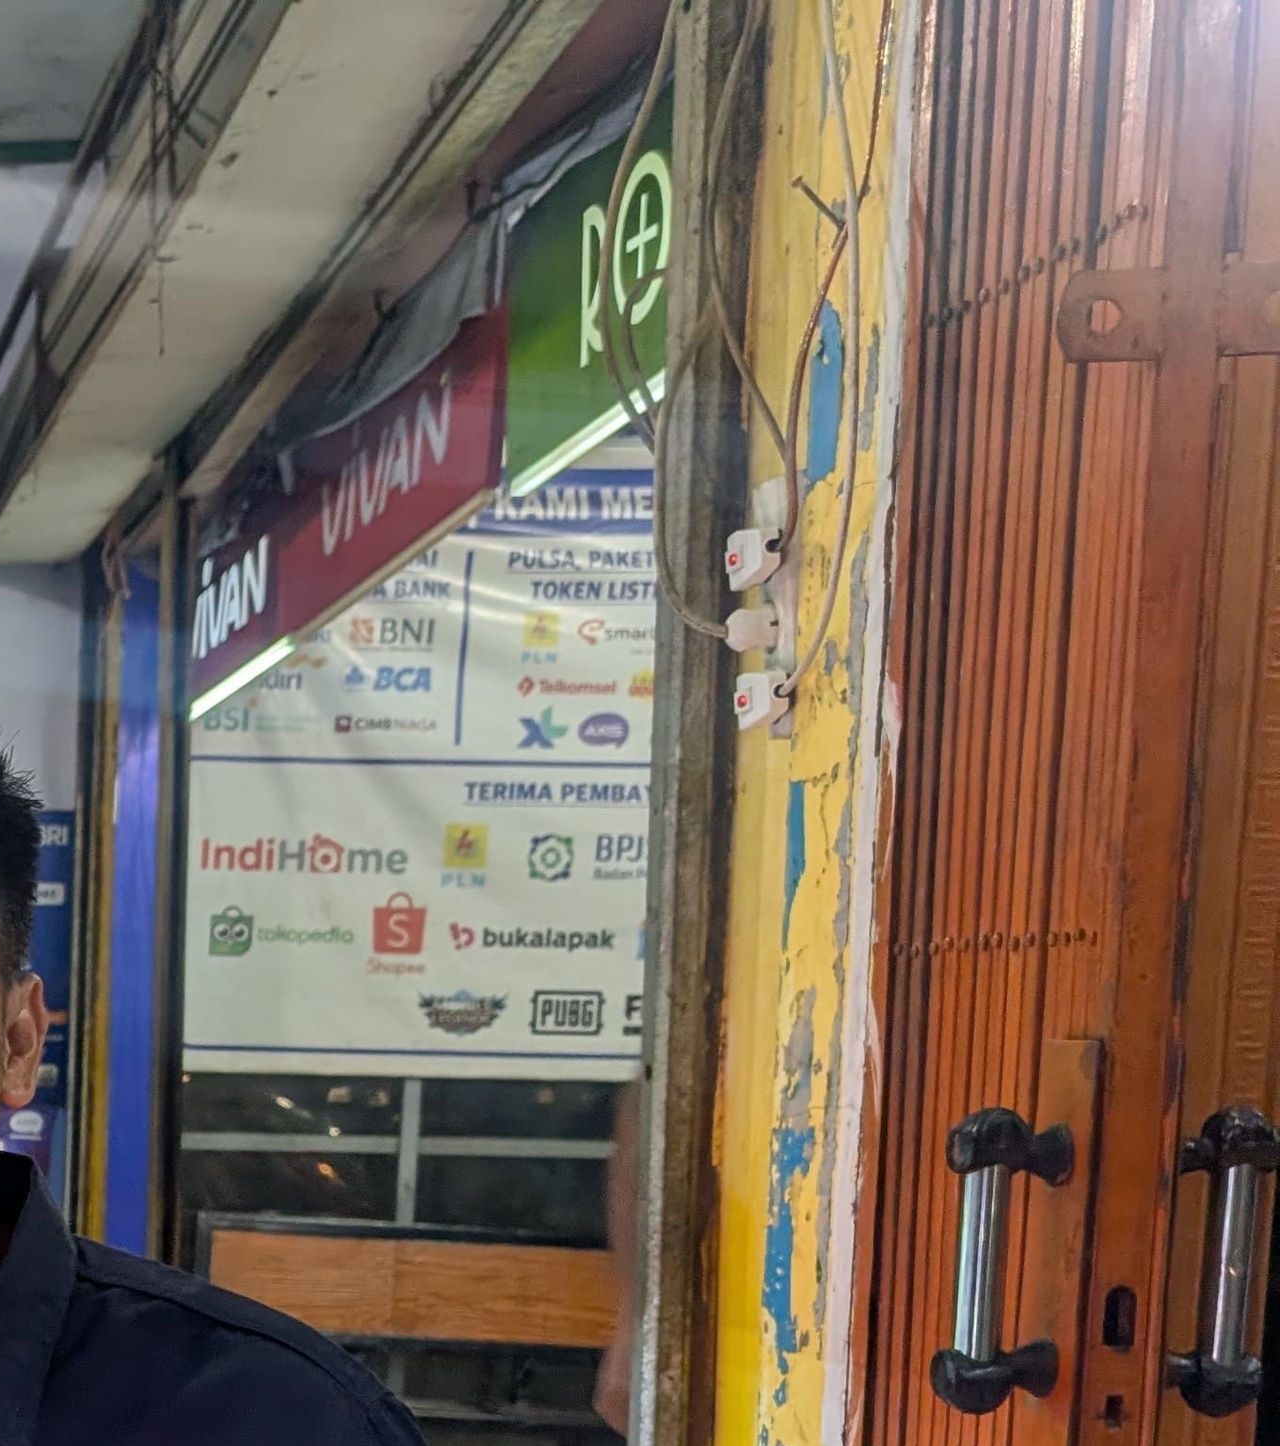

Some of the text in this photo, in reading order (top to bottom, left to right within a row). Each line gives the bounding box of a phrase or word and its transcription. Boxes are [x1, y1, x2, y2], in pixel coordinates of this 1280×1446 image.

[531, 581, 601, 600] TOKEN
[380, 618, 436, 644] BNI
[373, 666, 432, 692] BCA
[538, 678, 617, 695] Telkomsel
[464, 782, 553, 801] TERIMA
[200, 834, 409, 875] IndiHome
[595, 834, 648, 863] BPJ
[483, 926, 615, 952] bukalapak
[540, 999, 594, 1027] PUBG
